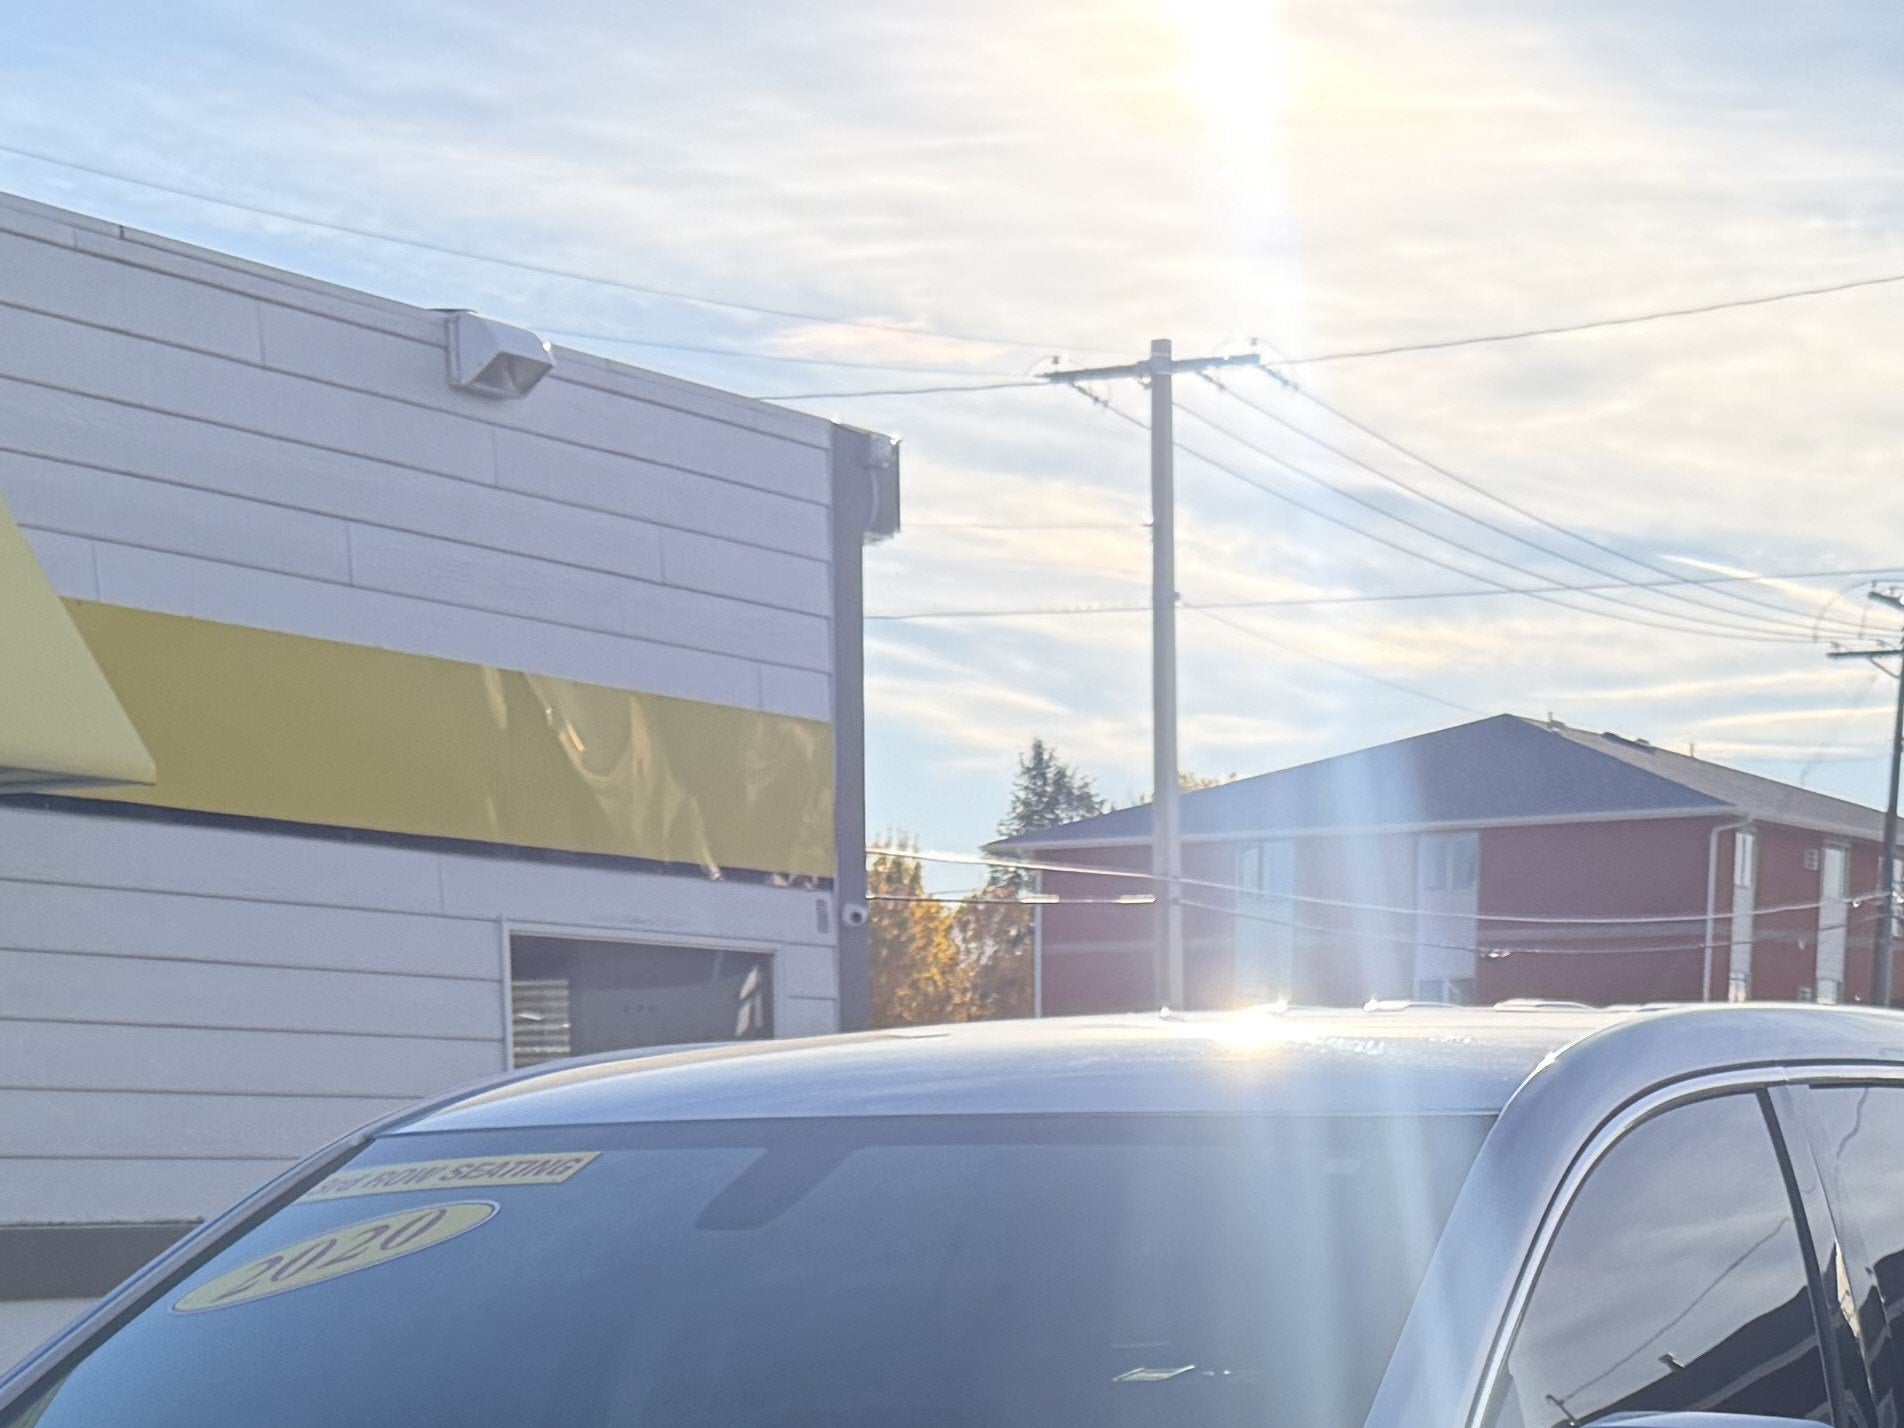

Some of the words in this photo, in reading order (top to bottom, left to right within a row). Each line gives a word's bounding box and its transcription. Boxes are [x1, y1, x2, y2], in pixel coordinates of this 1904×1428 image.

[360, 1166, 450, 1189] ROW
[439, 1157, 585, 1181] SEATING
[212, 1207, 448, 1303] 2020
